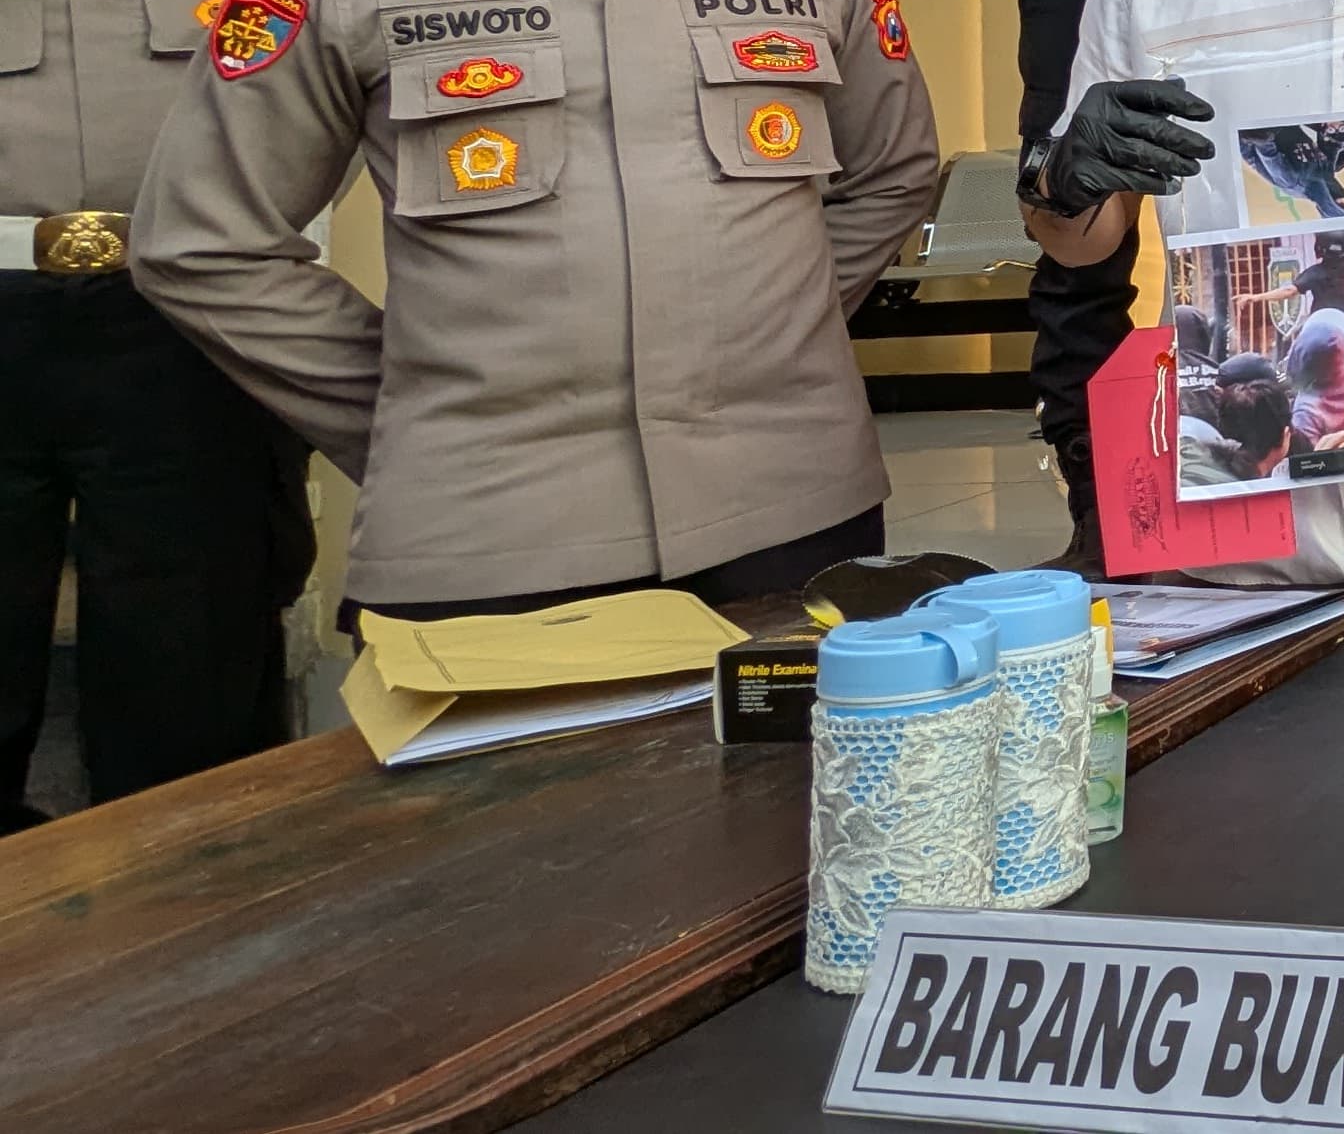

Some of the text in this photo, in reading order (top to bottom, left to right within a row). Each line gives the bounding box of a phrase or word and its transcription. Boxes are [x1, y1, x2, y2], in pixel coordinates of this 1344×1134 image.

[392, 4, 552, 45] SISWOTO
[738, 663, 818, 676] Nitrile Examina
[874, 953, 1200, 1094] BARANG
